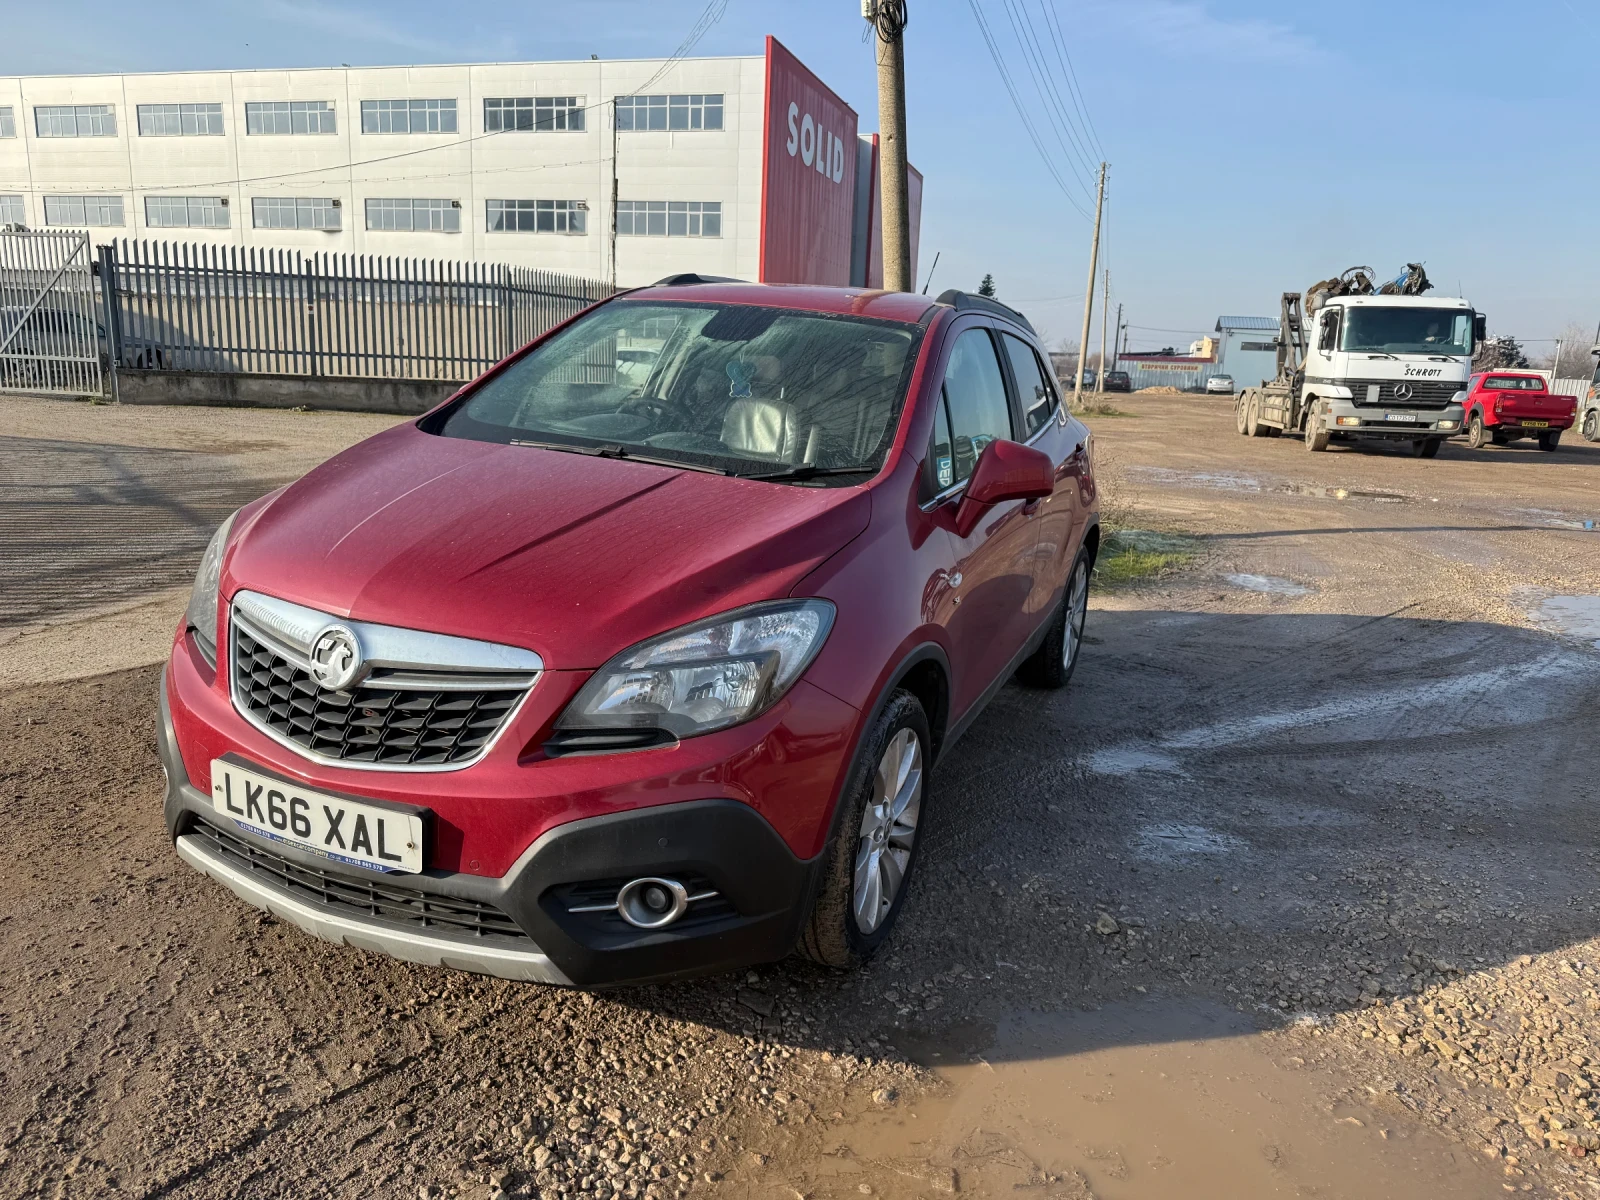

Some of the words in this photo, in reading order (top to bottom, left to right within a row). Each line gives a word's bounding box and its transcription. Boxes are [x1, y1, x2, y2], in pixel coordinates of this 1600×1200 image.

[787, 102, 844, 184] SOLID
[1404, 368, 1442, 377] SCHROTT
[224, 772, 311, 838] LK66
[323, 804, 402, 863] XAL
